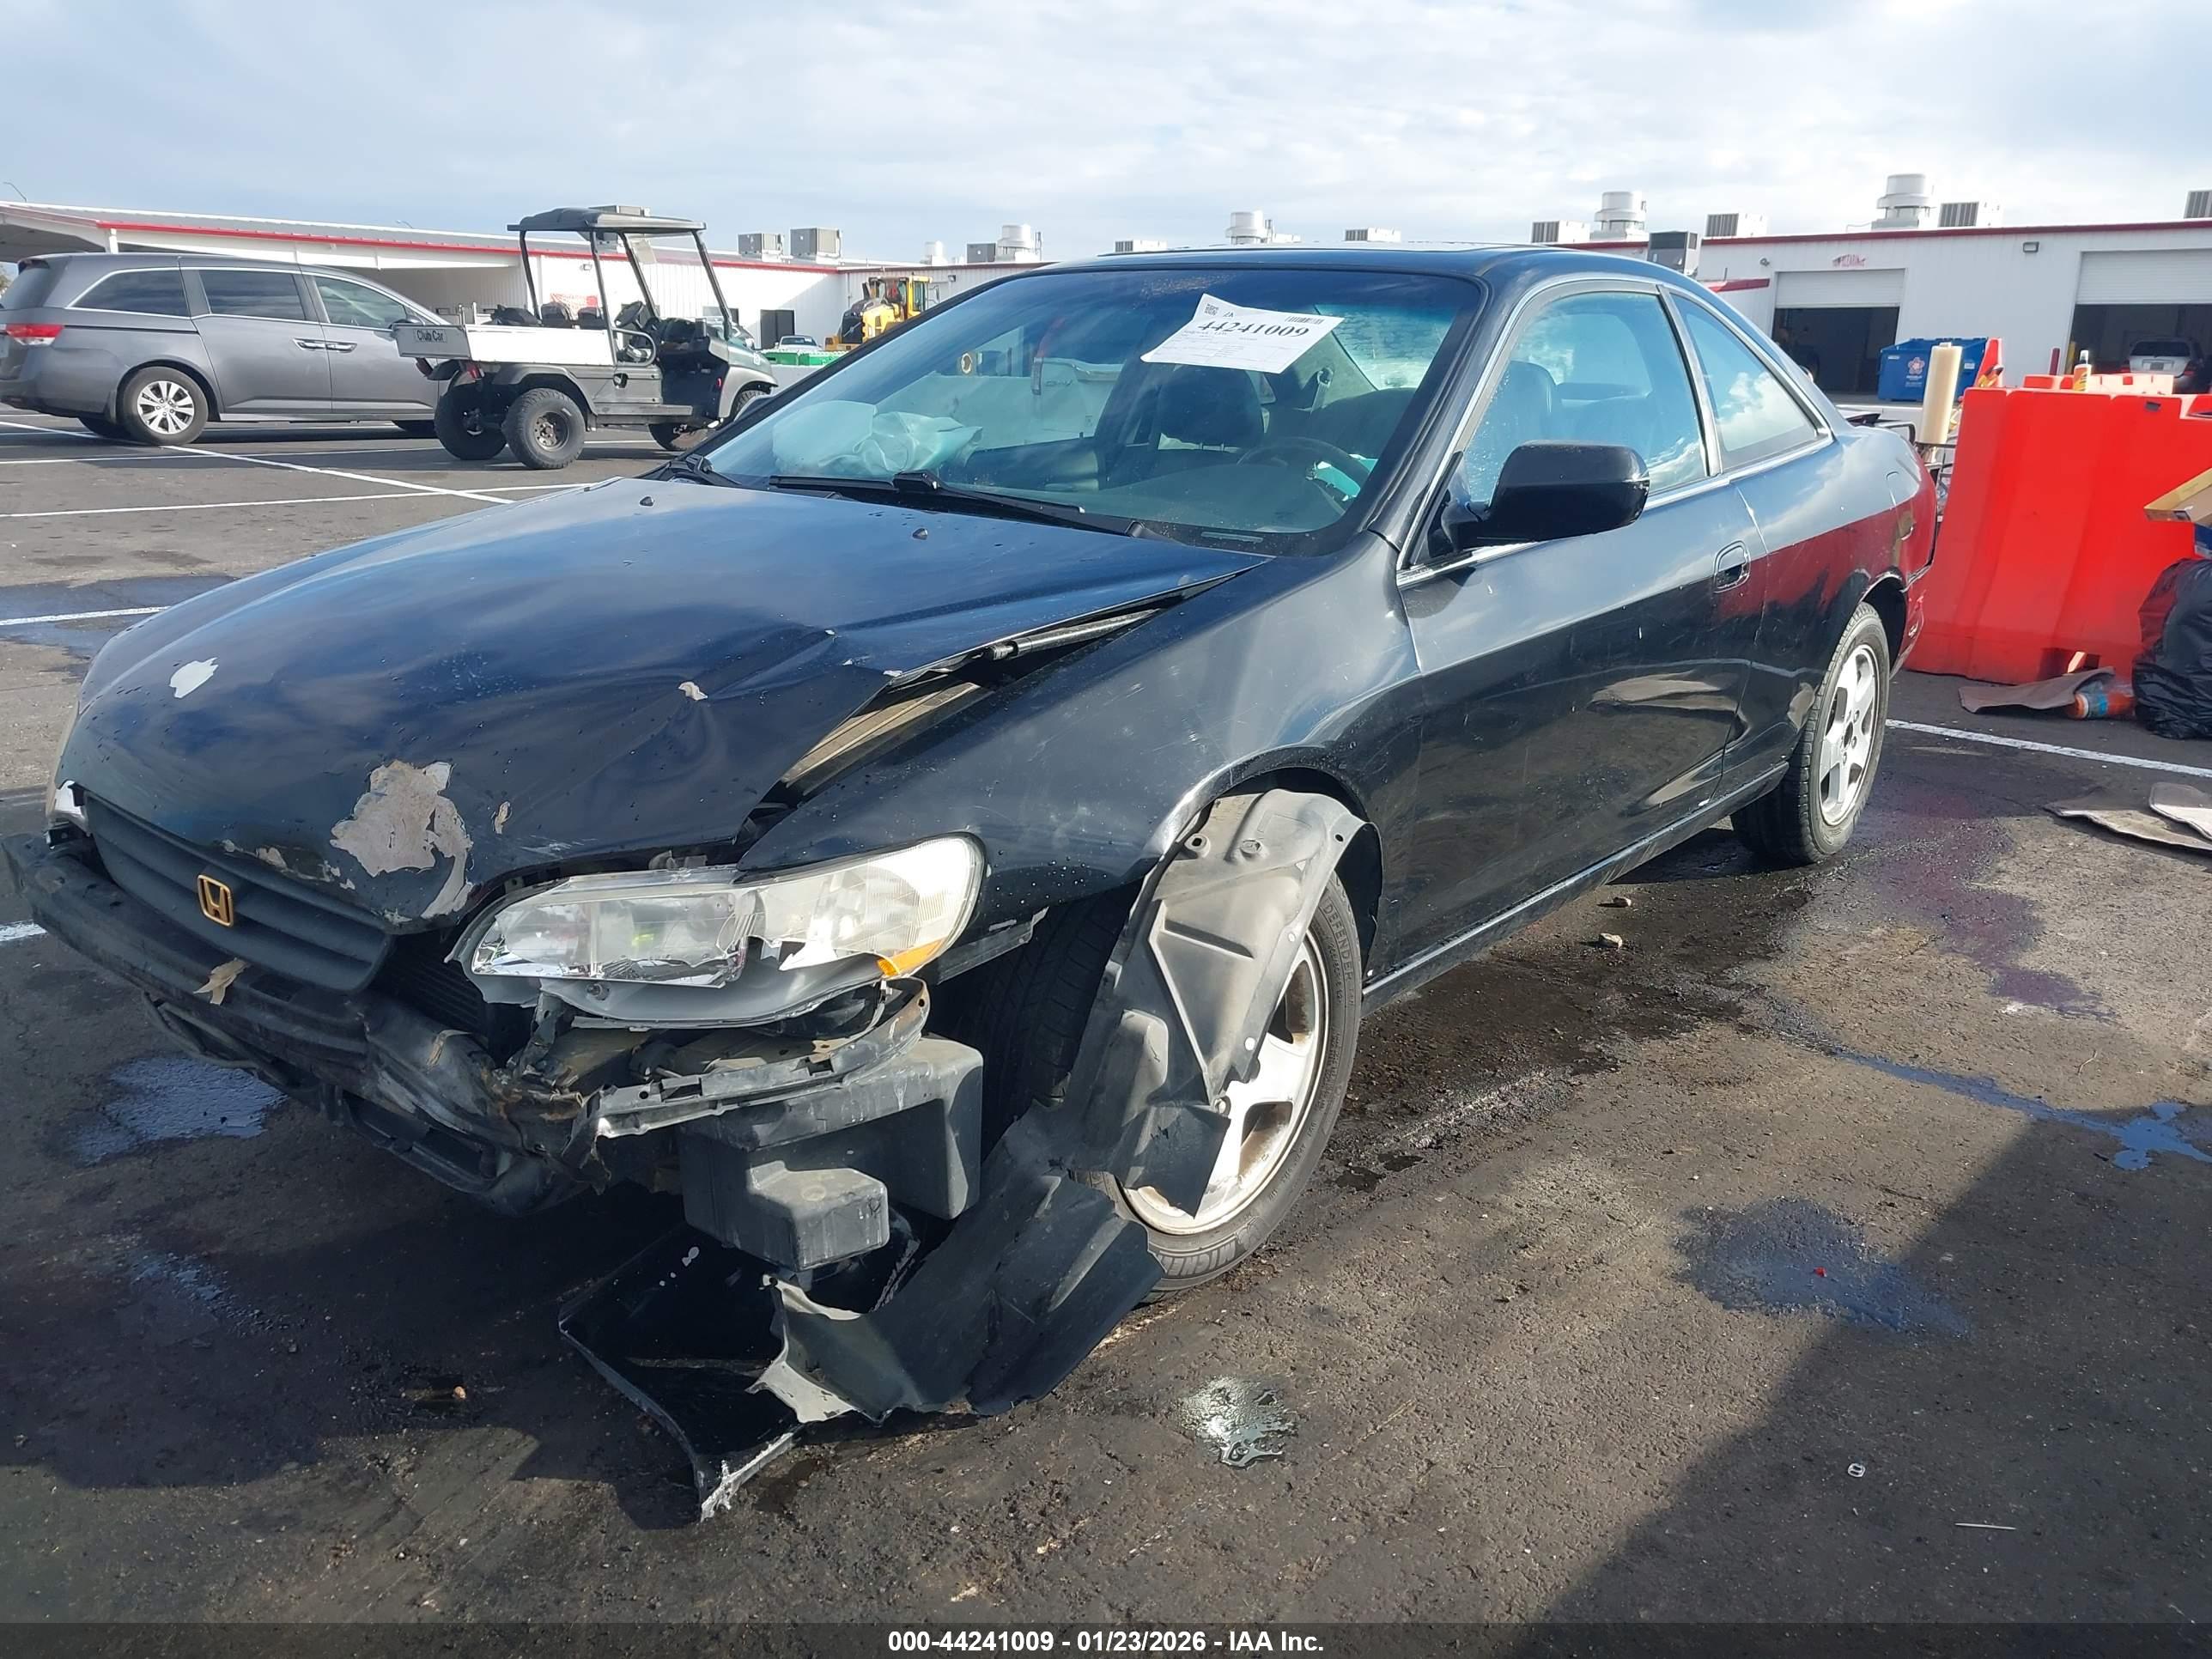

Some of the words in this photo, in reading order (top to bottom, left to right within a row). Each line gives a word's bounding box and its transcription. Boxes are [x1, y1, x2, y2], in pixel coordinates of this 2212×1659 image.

[417, 330, 431, 341] Club
[432, 330, 443, 341] Car
[1199, 321, 1310, 337] 44241009
[1323, 901, 1354, 981] DEFENDER
